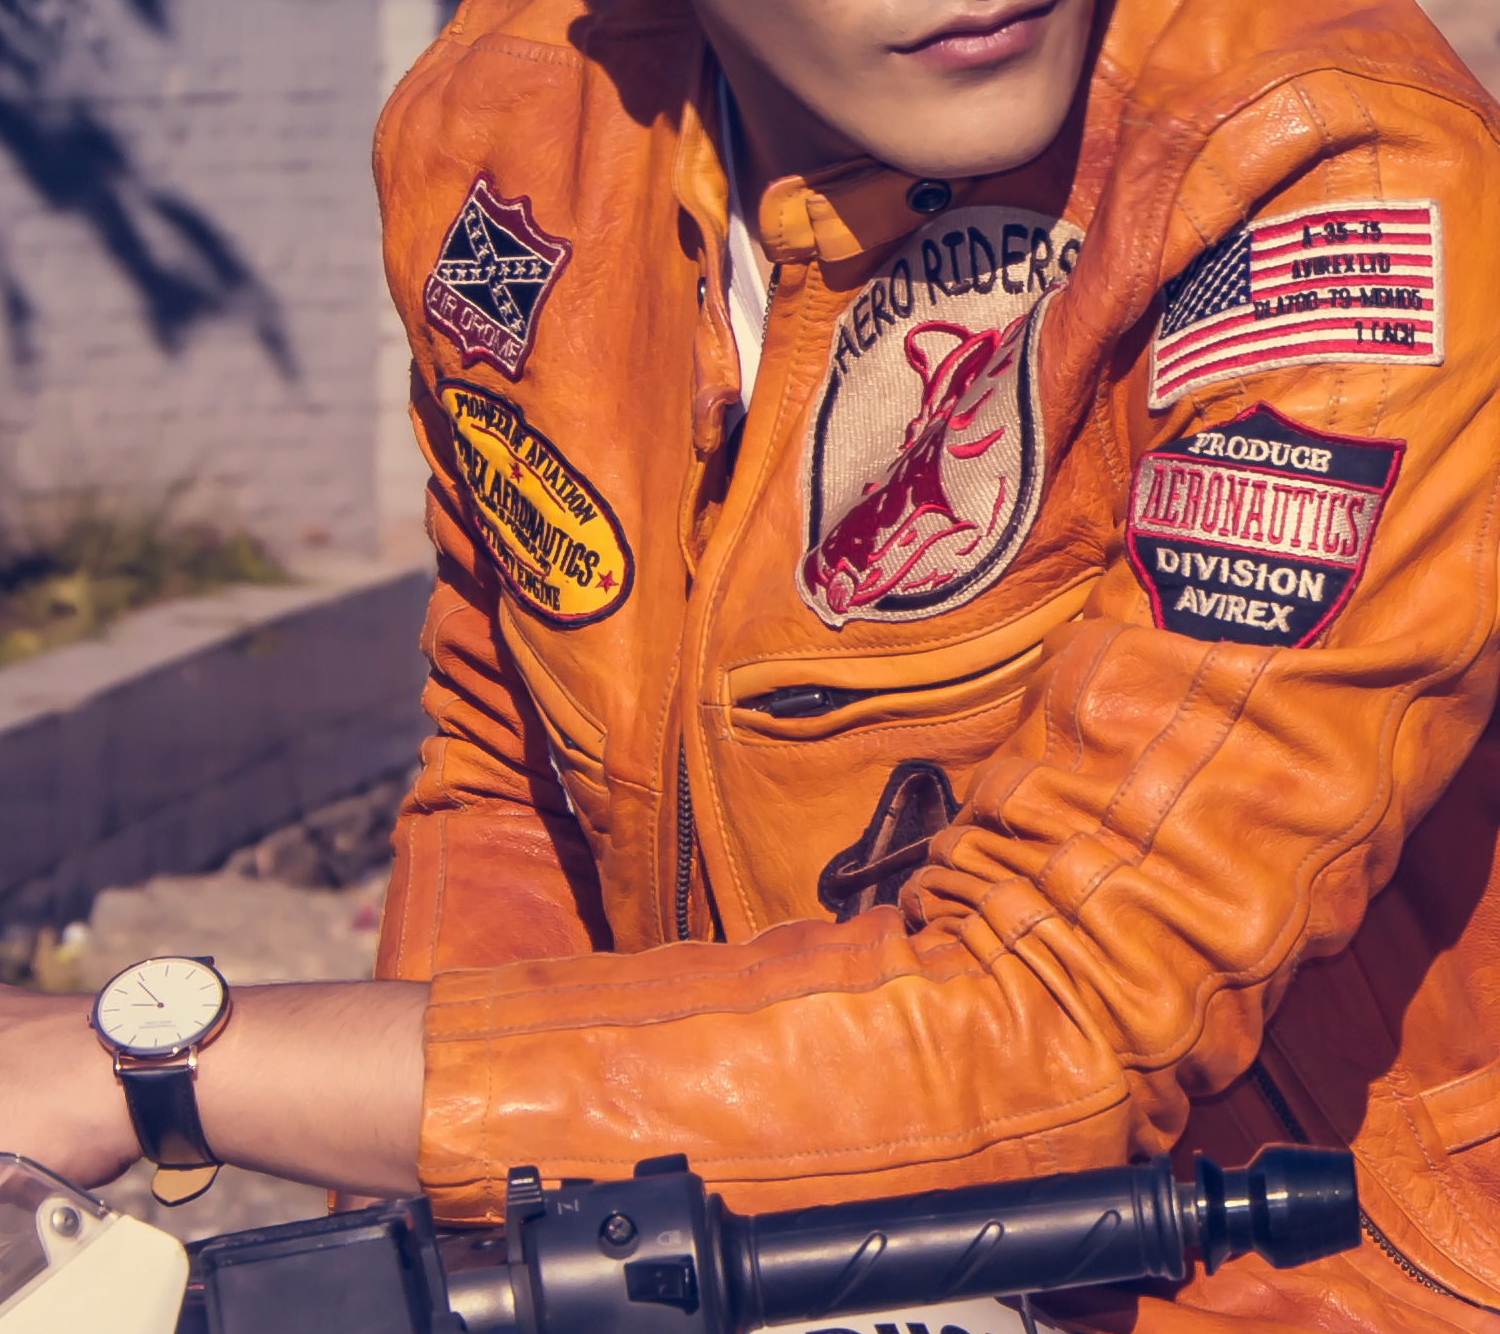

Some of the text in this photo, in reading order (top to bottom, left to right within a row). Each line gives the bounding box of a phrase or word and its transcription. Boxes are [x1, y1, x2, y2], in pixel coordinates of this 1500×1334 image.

[427, 284, 458, 316] AIR
[834, 259, 915, 374] AERO
[1188, 432, 1332, 473] PRODUCE
[525, 435, 598, 526] AVIATION
[1139, 464, 1366, 558] AERONAUTICS
[1156, 547, 1326, 602] DIVISION
[1174, 584, 1294, 633] AVIREX
